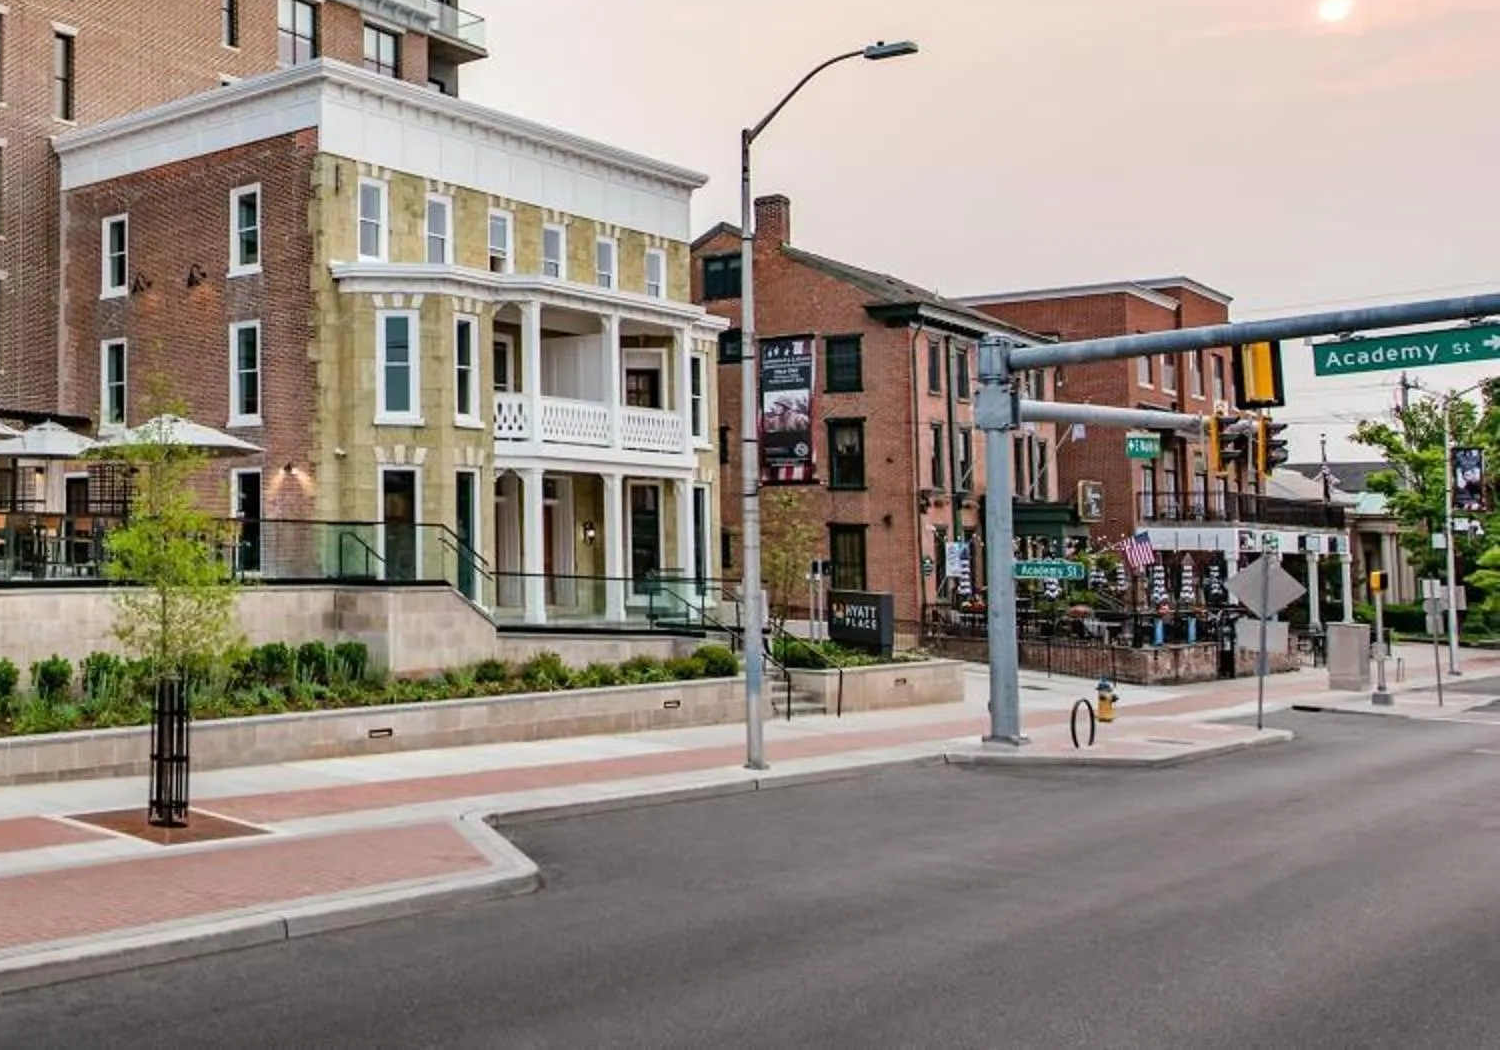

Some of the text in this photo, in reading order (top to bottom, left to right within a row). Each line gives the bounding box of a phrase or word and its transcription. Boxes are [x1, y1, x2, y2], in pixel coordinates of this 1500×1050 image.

[1325, 341, 1471, 368] Academy St
[845, 603, 876, 618] HYATT
[845, 617, 877, 630] PLACE
